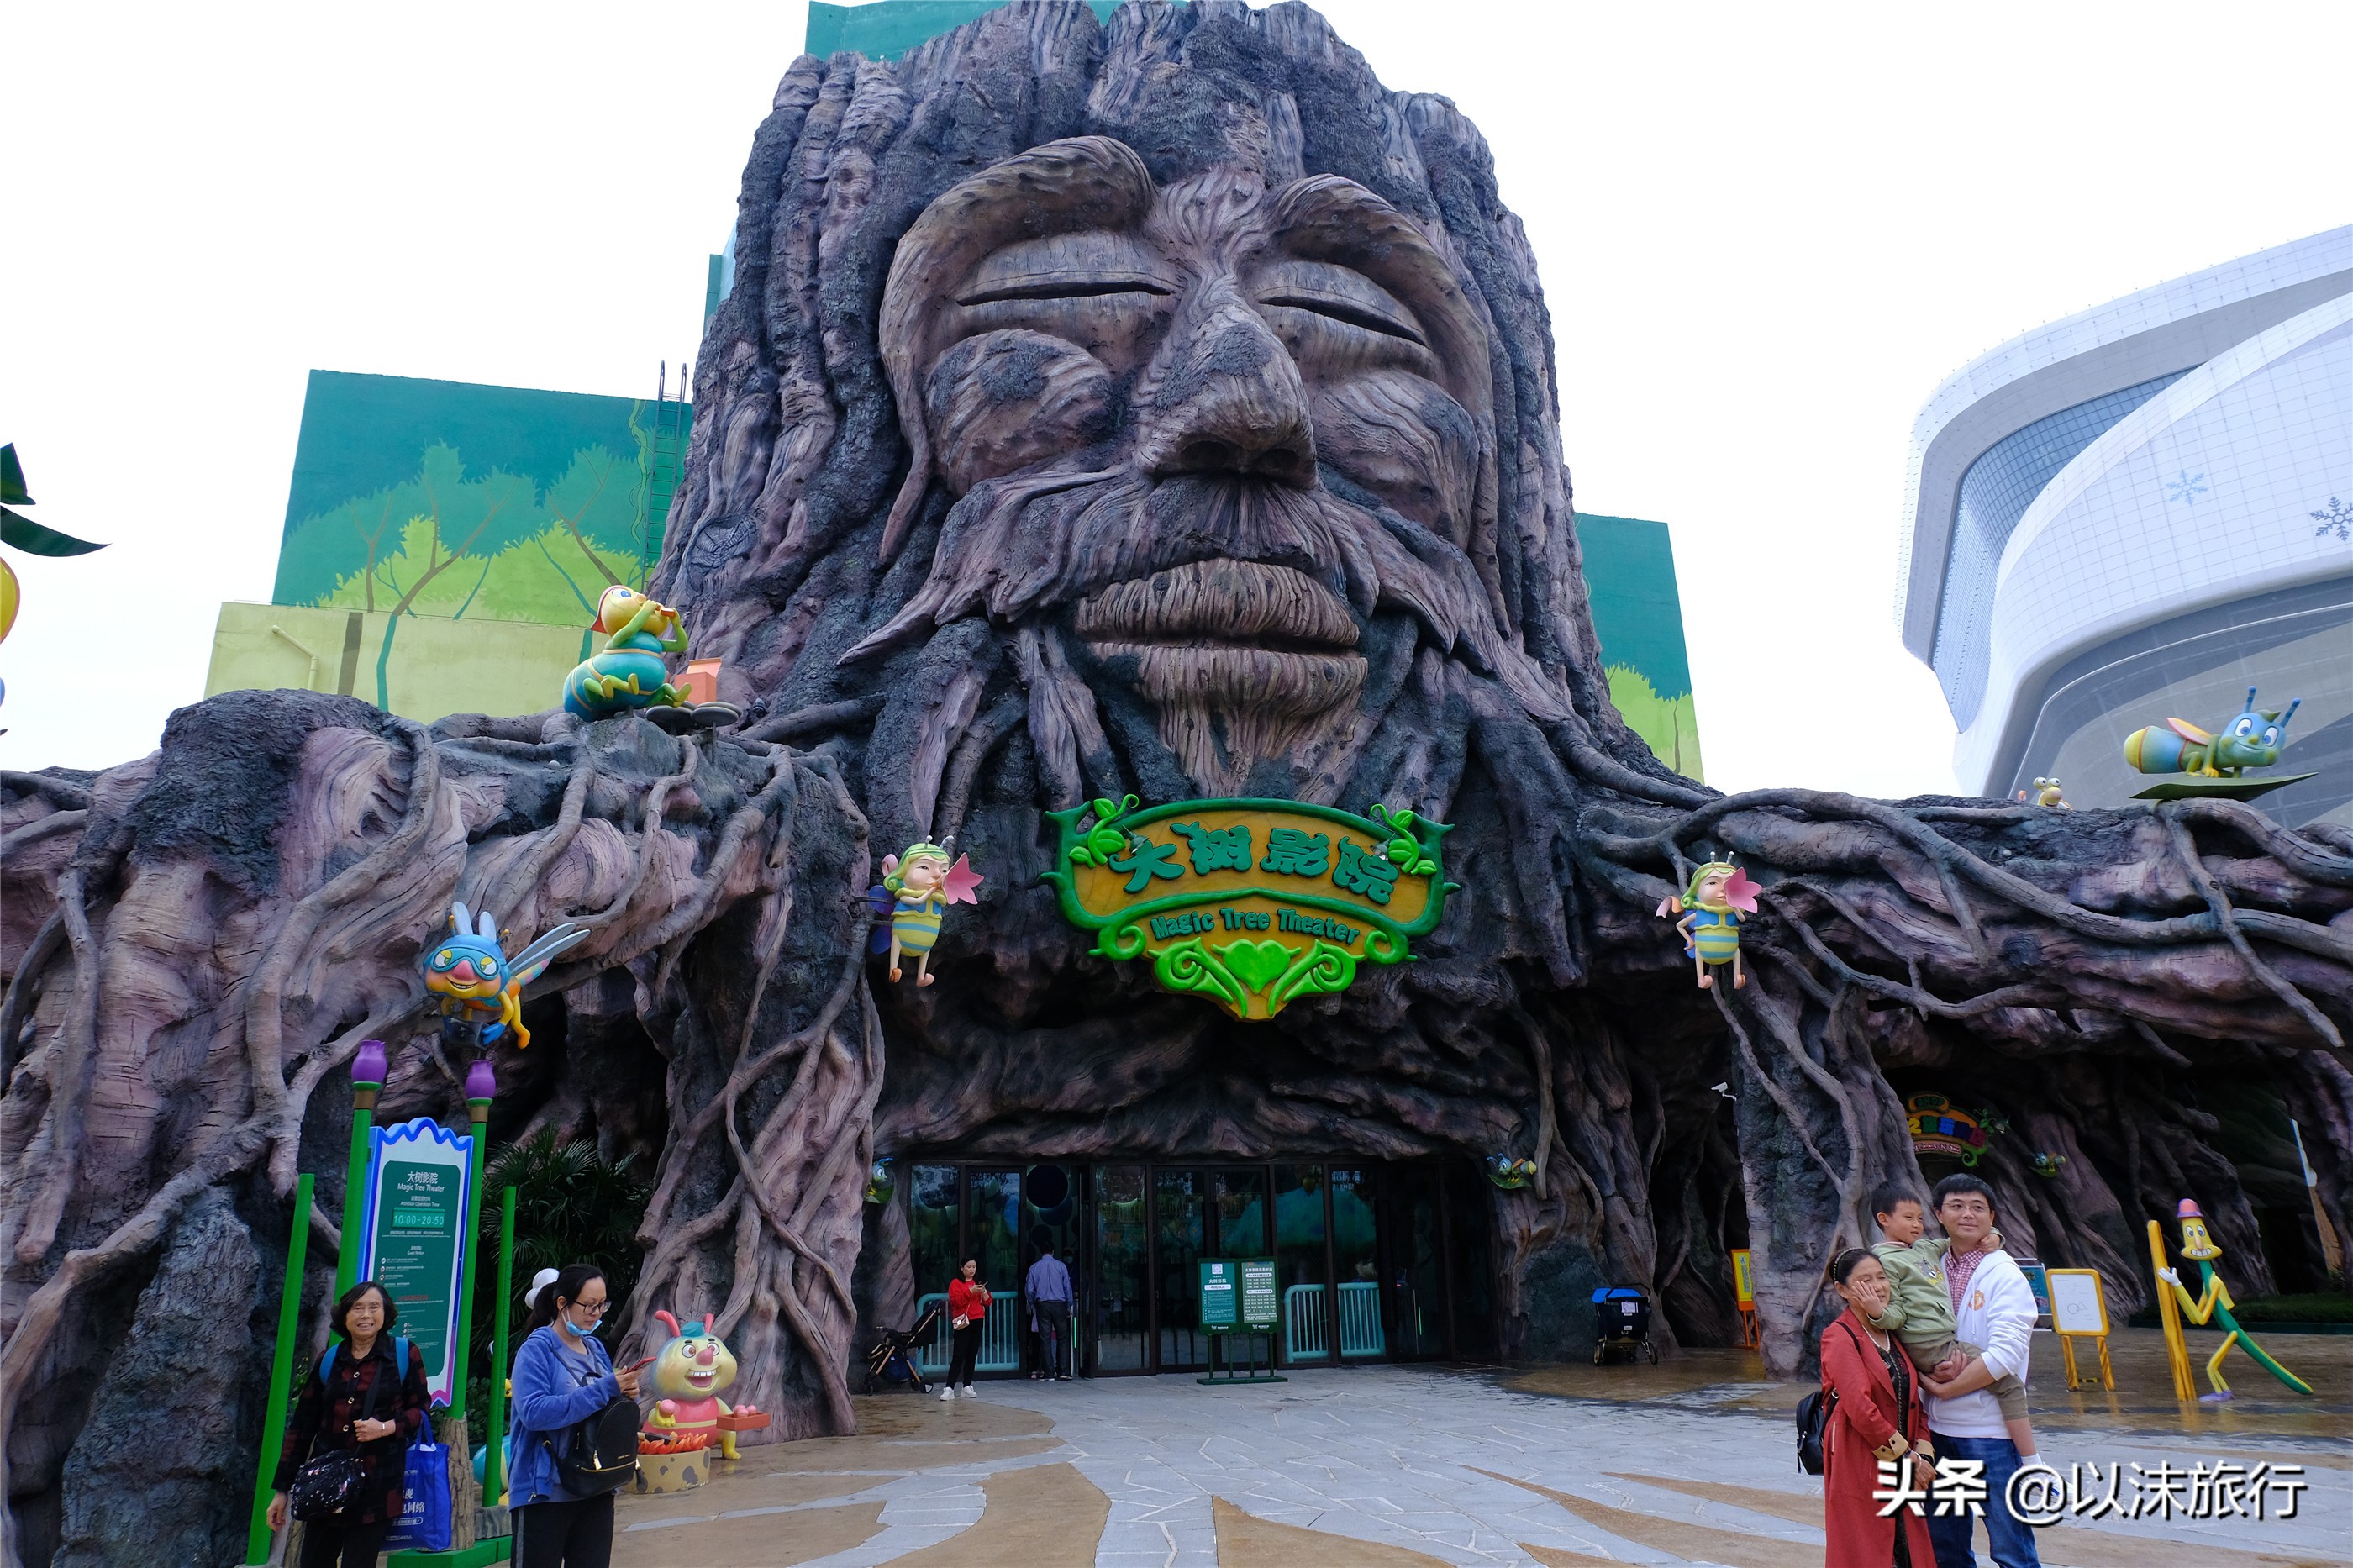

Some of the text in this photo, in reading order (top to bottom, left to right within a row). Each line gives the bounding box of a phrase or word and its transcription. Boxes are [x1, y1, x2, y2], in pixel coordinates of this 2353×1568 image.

[1108, 822, 1400, 904] 大树影院
[1150, 907, 1361, 944] Magic Tree Theater
[397, 1182, 445, 1192] Magic Tree Theater
[407, 1171, 439, 1184] 大树影院
